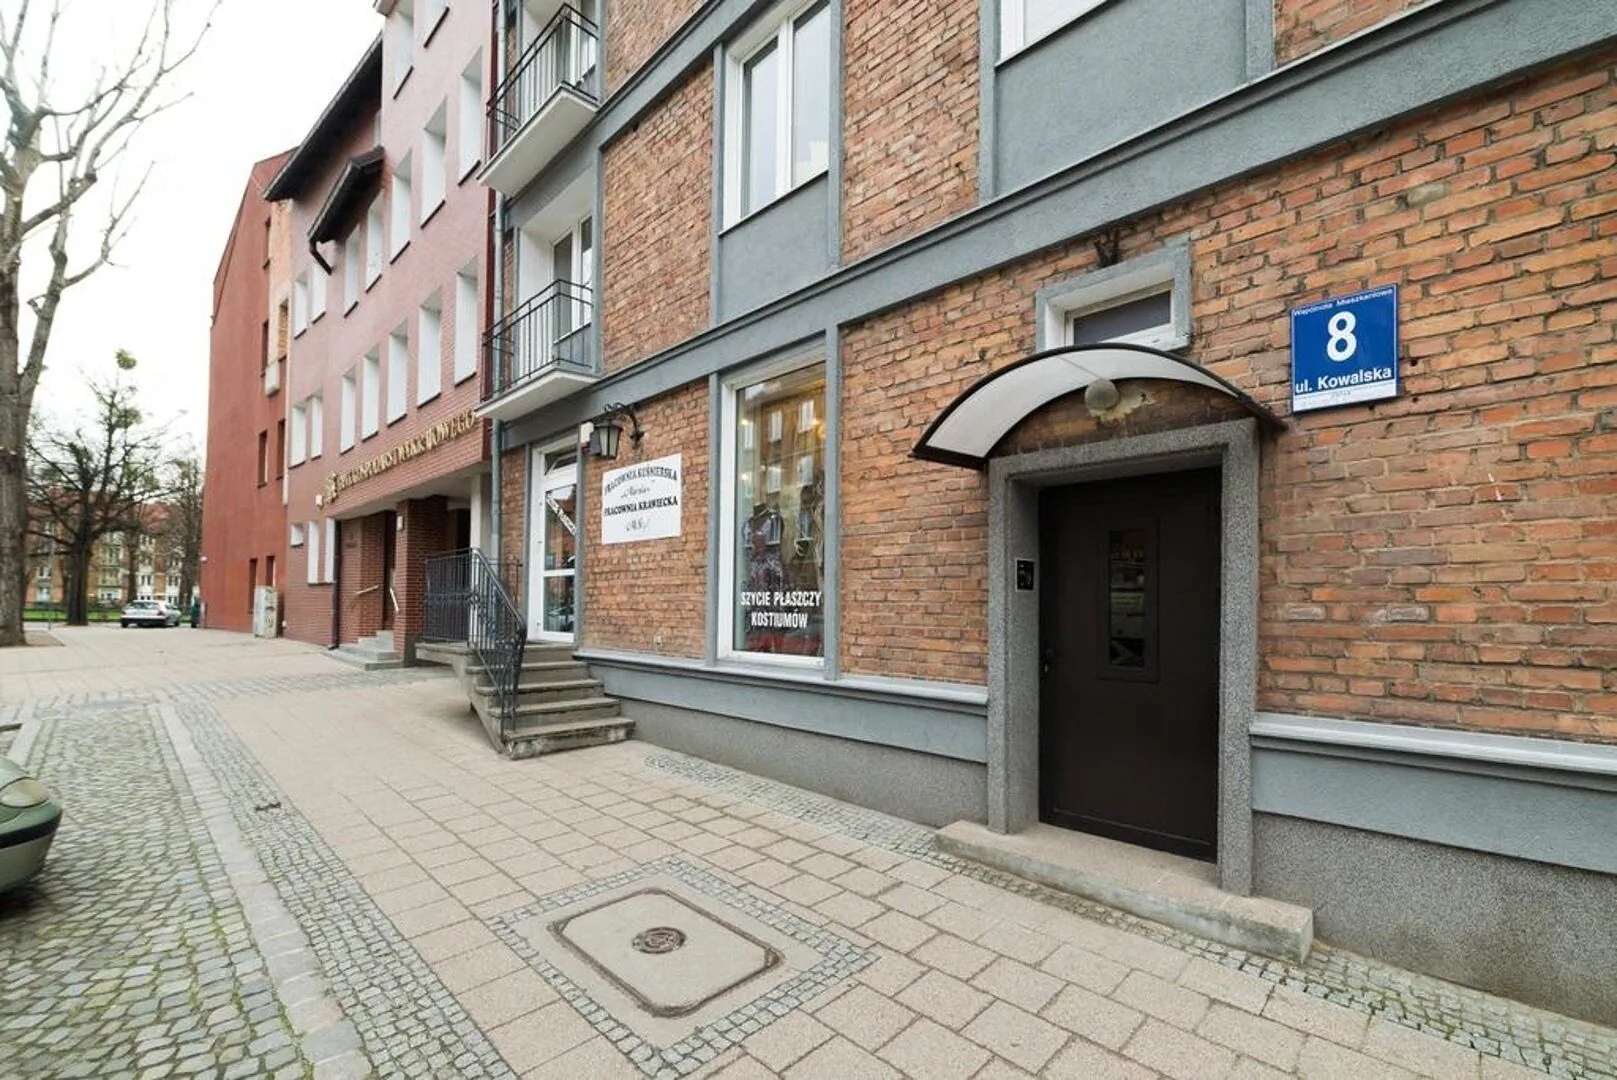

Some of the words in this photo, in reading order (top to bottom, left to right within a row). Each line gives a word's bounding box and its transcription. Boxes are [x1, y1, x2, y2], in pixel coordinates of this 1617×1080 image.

[1327, 310, 1358, 362] 8
[1295, 378, 1313, 394] ul.
[1317, 367, 1392, 390] Kowalska
[638, 495, 679, 512] KRAWIECKA
[740, 591, 772, 607] SZYCIE
[773, 591, 822, 607] PŁASZCZY
[751, 608, 808, 628] KOSTIUMÓW
